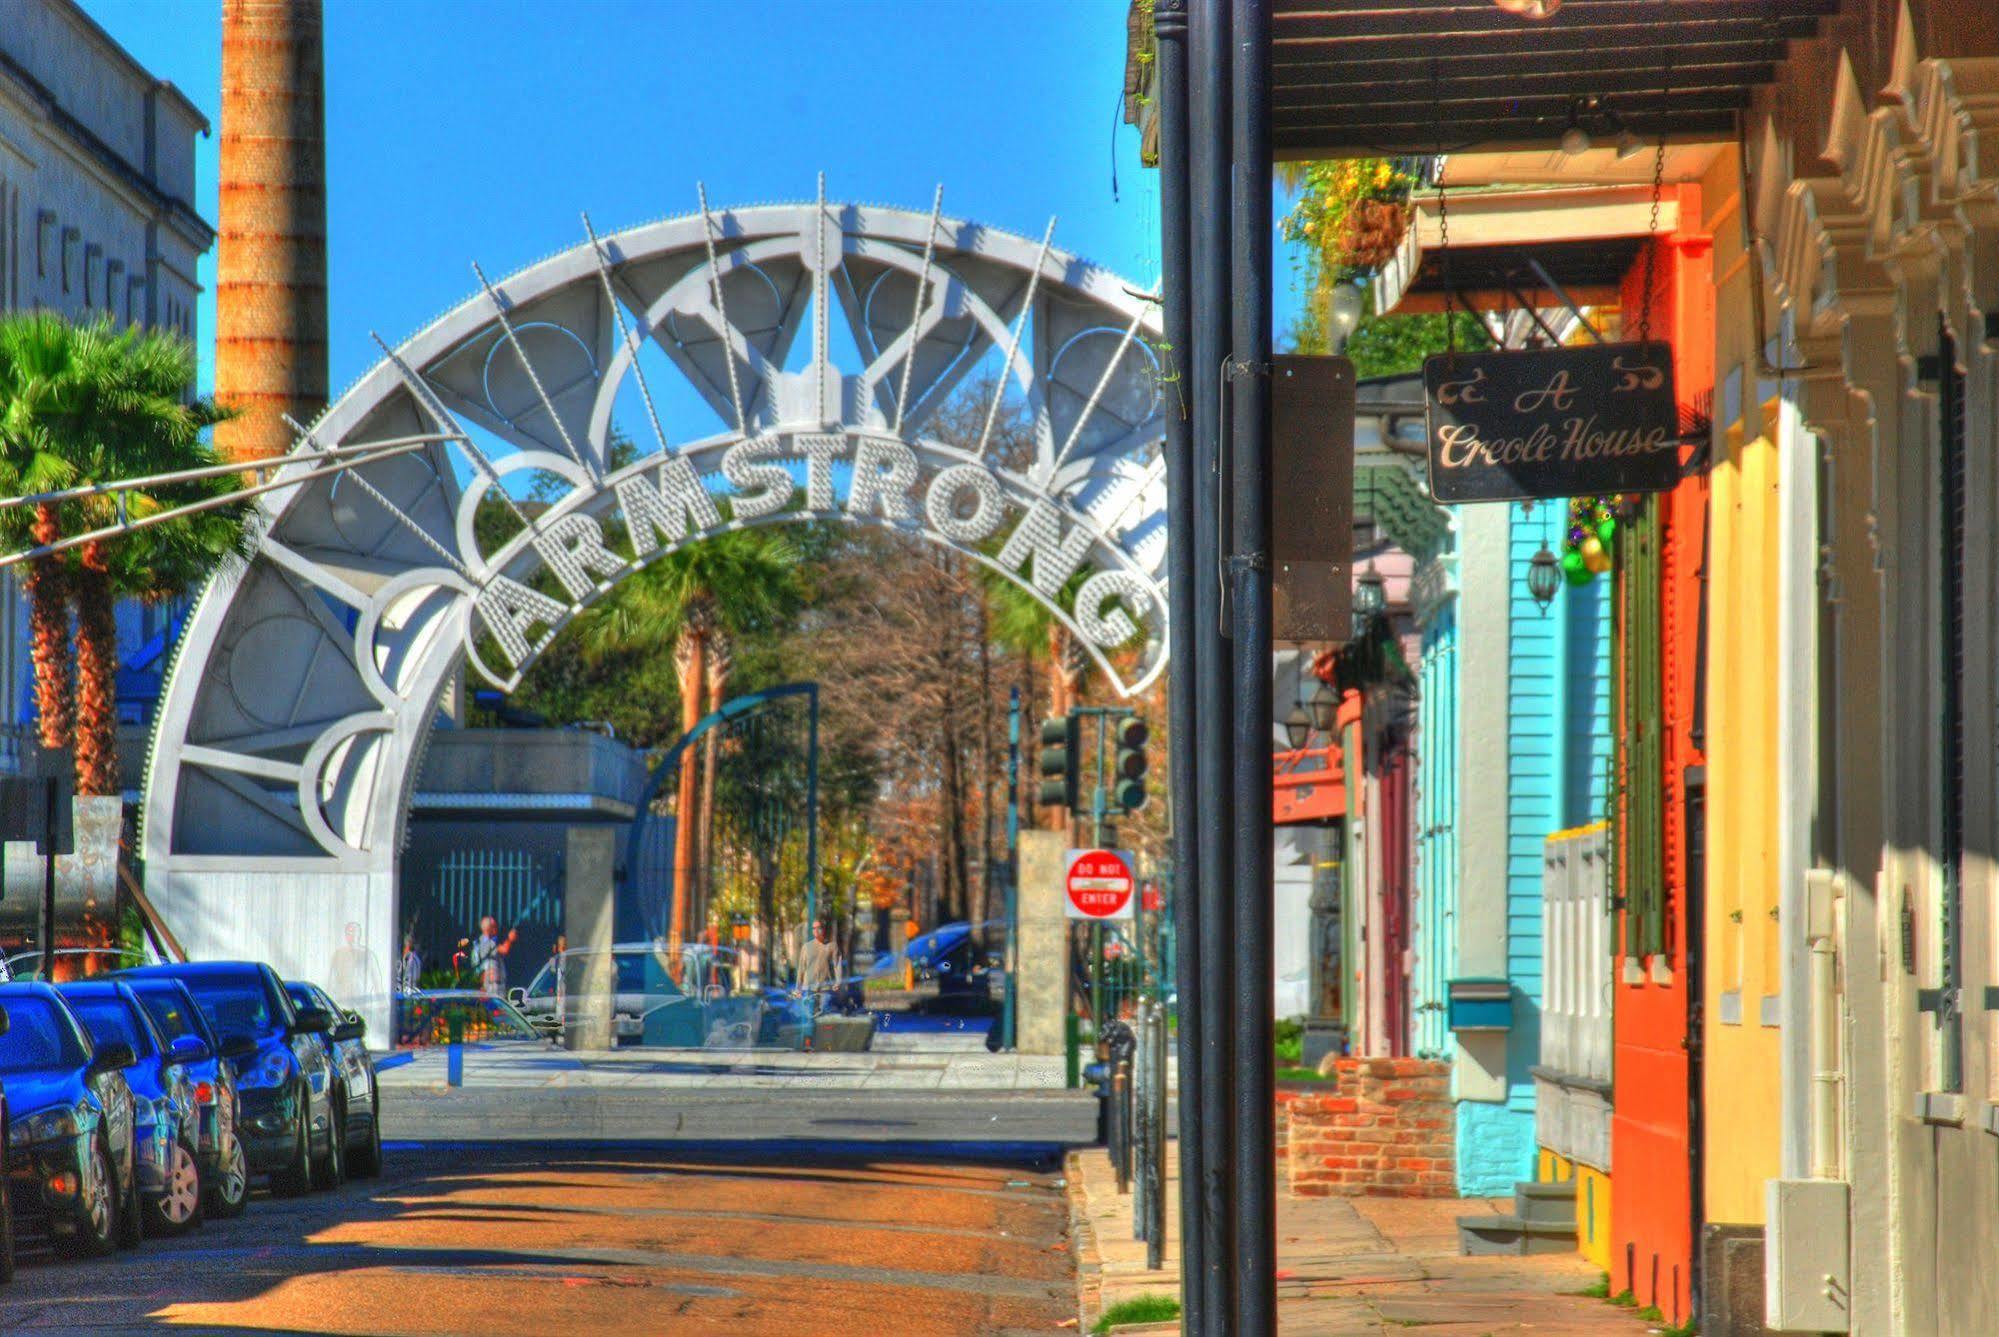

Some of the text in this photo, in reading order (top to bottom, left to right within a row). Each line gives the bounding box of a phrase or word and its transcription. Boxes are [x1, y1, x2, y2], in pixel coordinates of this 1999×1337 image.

[1514, 369, 1582, 412] A
[1437, 415, 1668, 468] Creole House
[475, 432, 1155, 671] ARMSTRONG
[1077, 863, 1121, 875] DO NOT
[1081, 892, 1118, 905] ENTER
